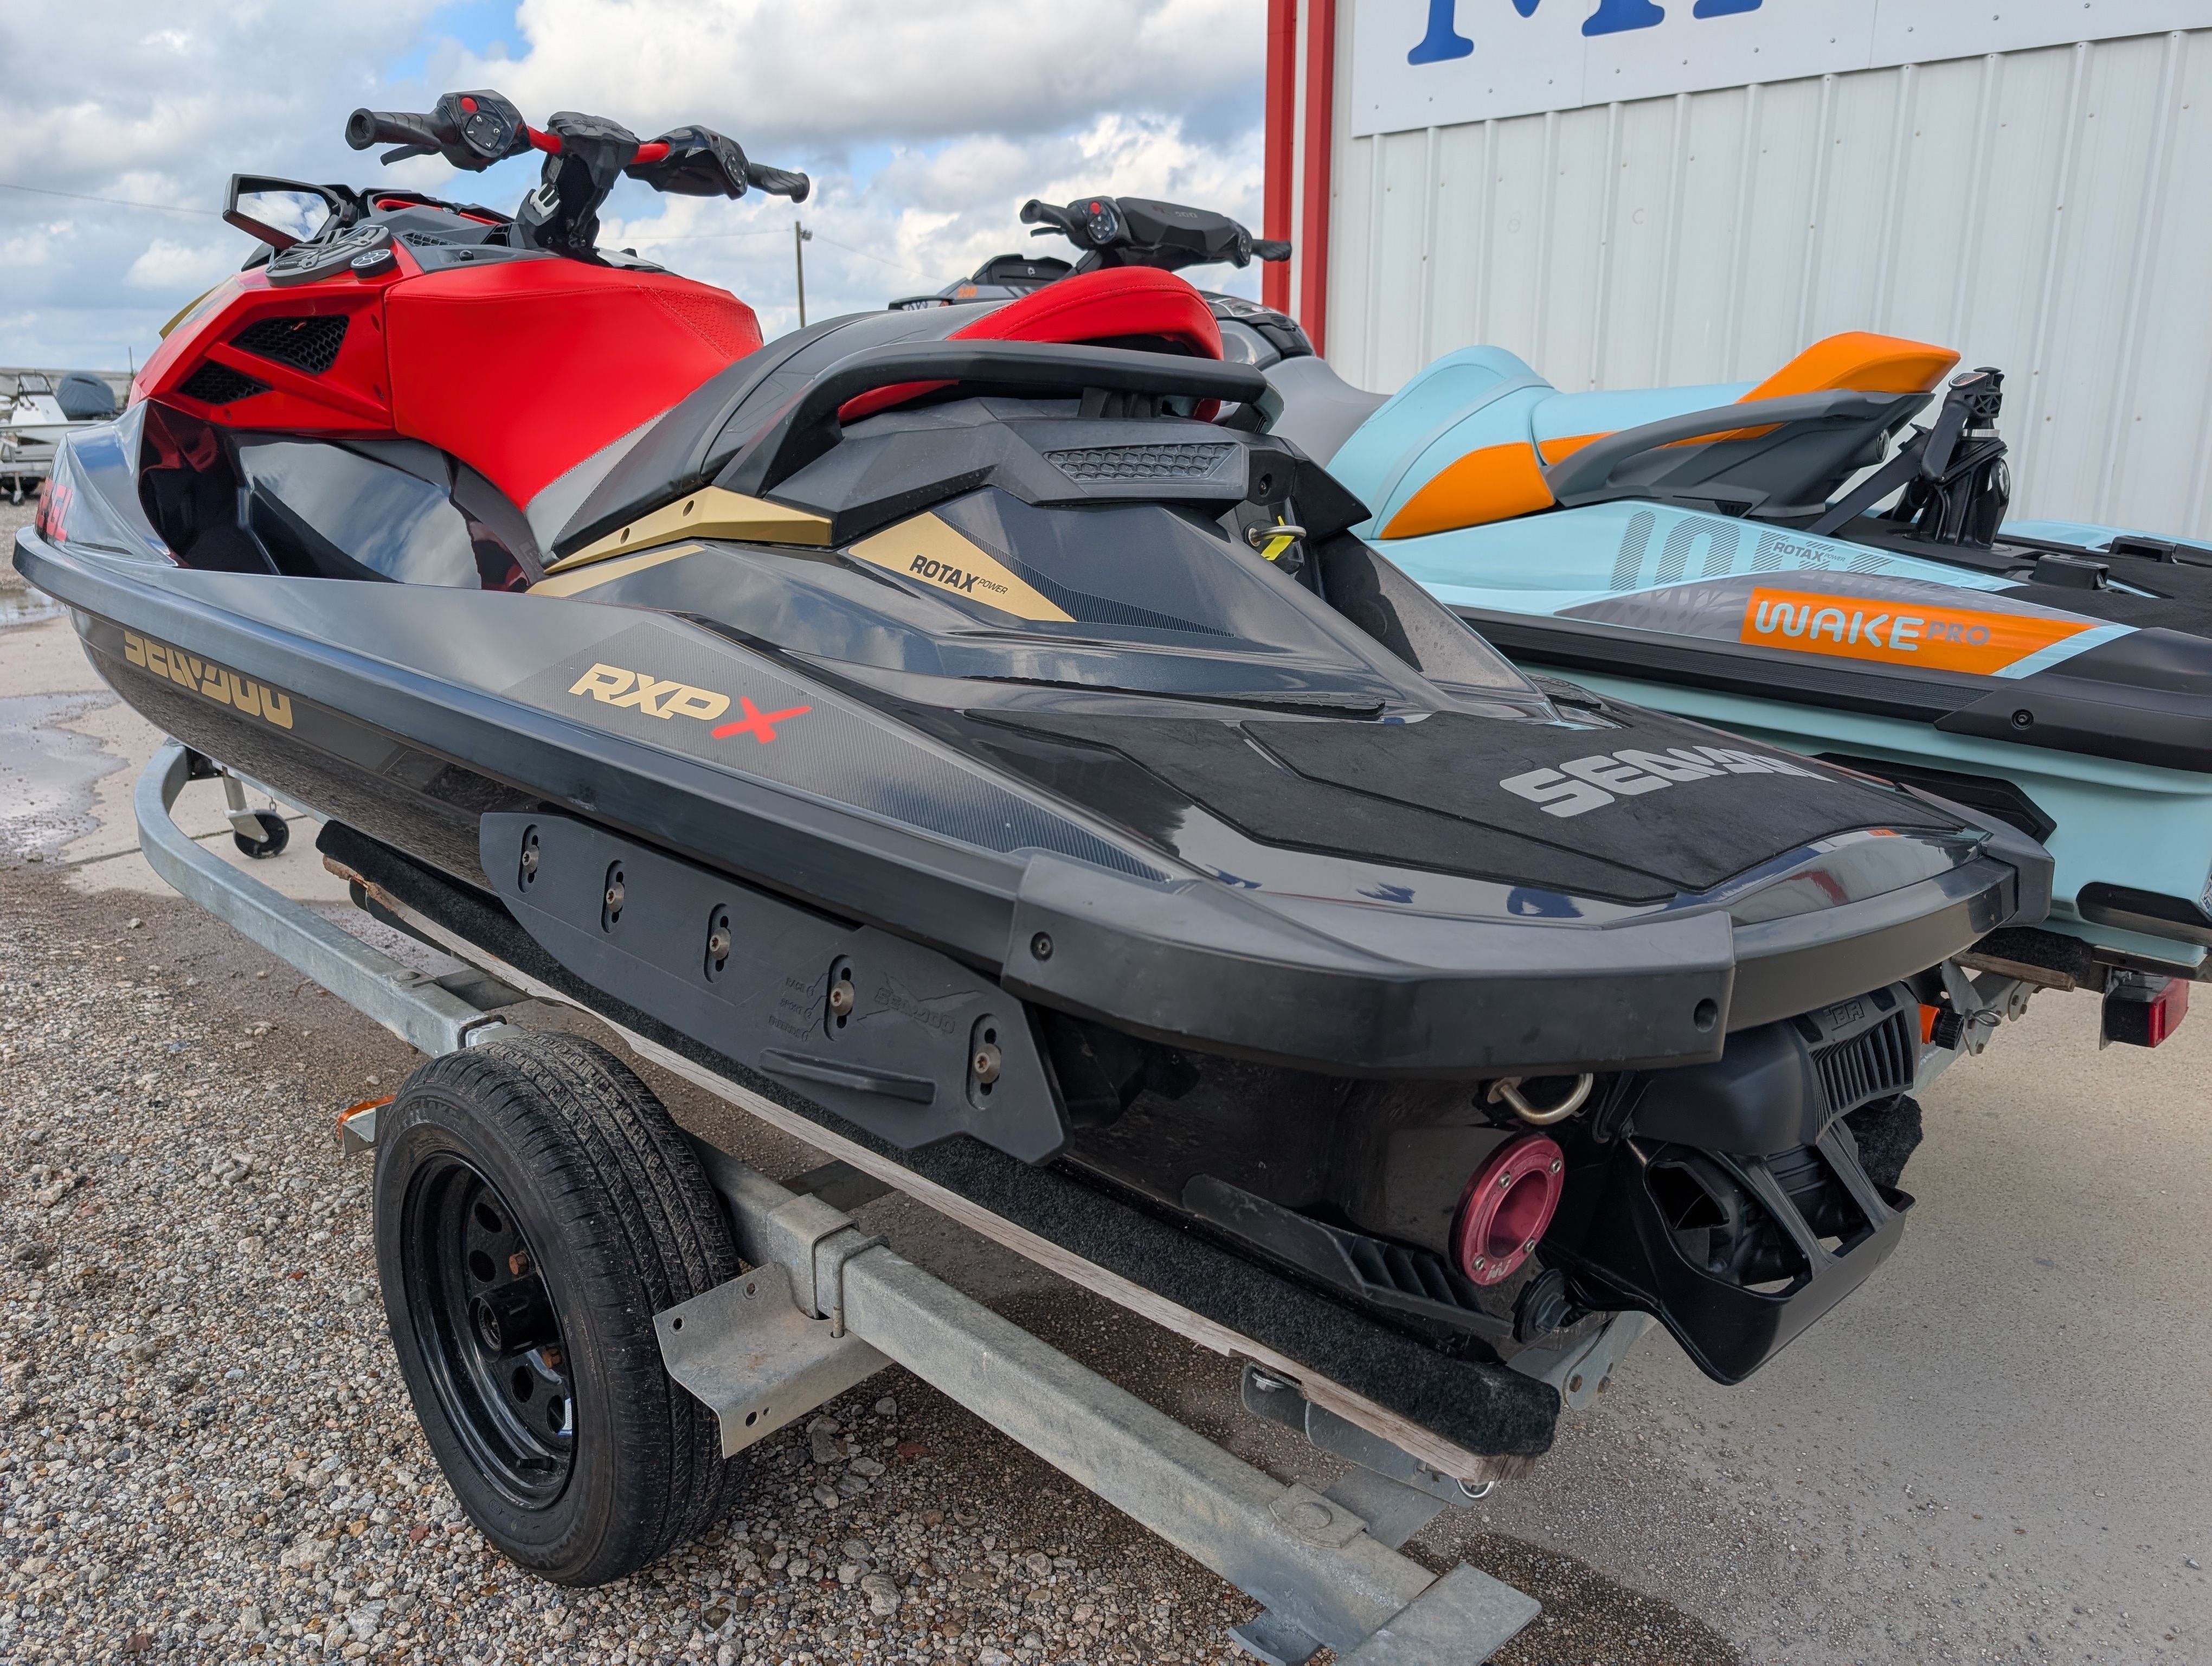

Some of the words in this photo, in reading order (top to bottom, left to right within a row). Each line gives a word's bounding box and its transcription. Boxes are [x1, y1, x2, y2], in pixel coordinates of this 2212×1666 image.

[957, 286, 977, 298] 230
[1772, 541, 1825, 562] ROTAX
[1823, 553, 1846, 562] POWER
[909, 554, 980, 593] ROTAX
[977, 578, 1008, 594] POWER
[1754, 601, 1925, 651] WAKE
[1926, 620, 1991, 646] PRO
[568, 662, 731, 720] RXP
[711, 695, 813, 744] X
